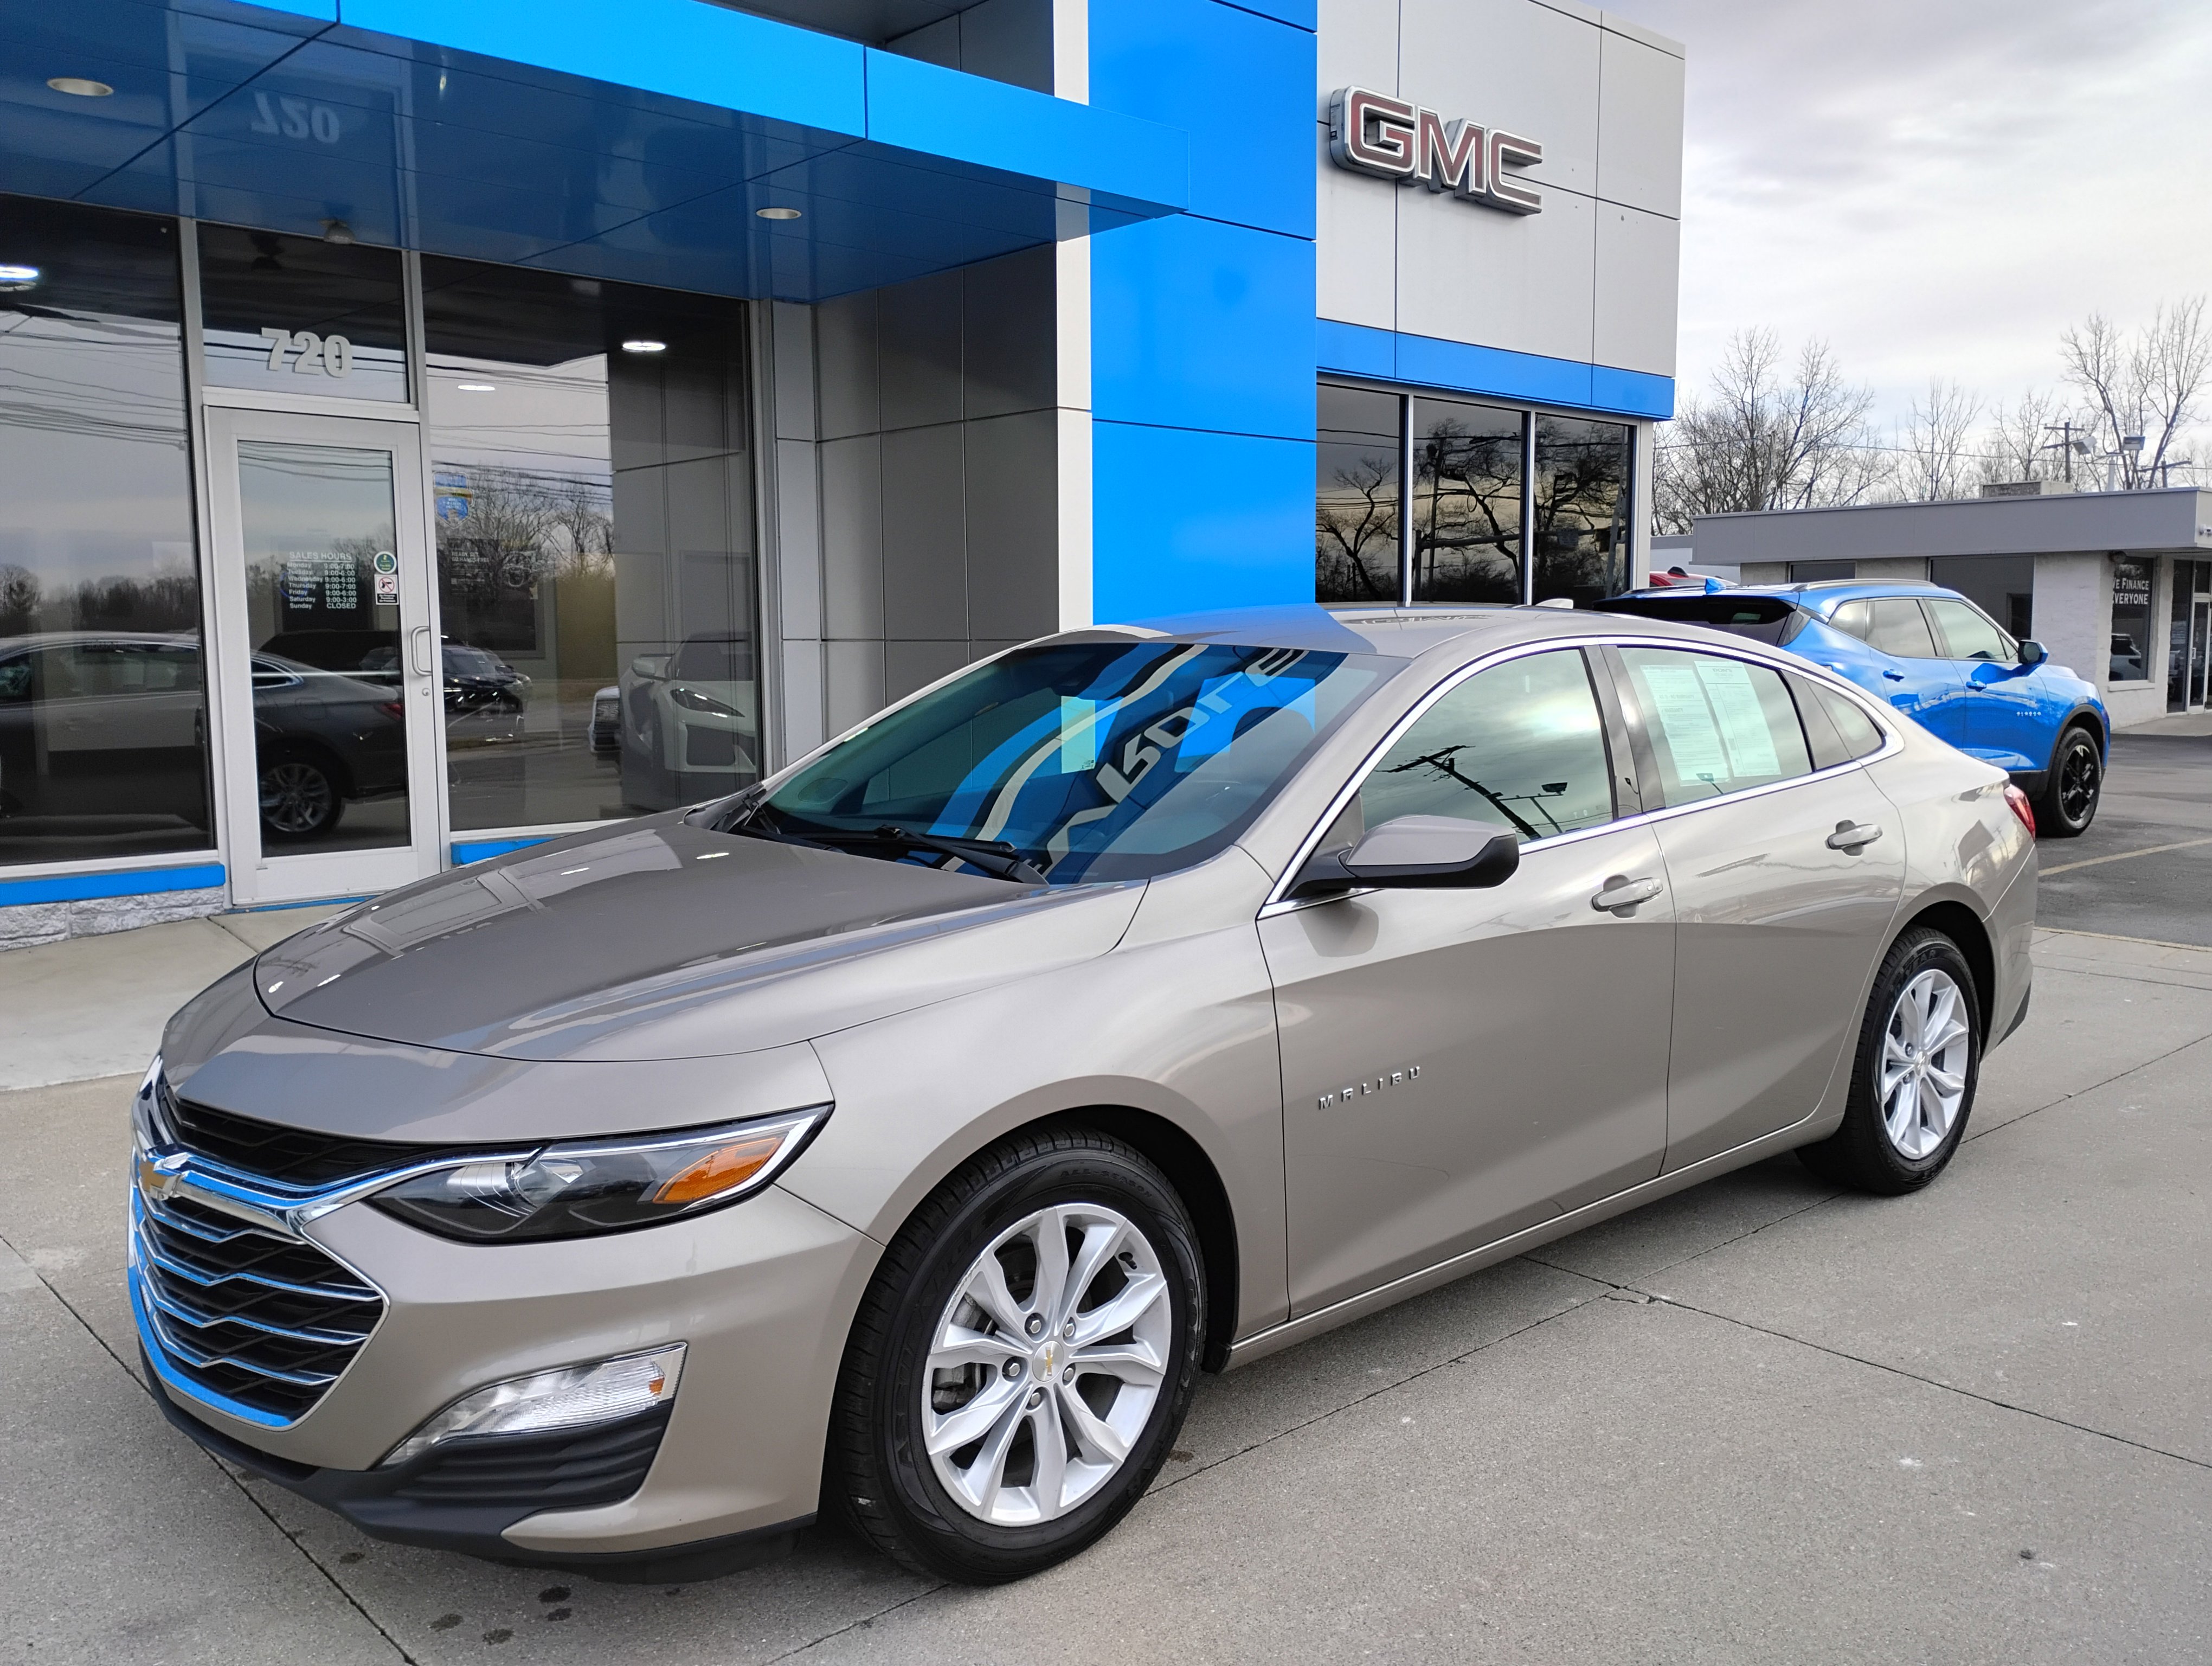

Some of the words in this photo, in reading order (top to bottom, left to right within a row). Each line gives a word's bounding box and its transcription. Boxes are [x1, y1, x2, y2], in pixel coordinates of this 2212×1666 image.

[1330, 86, 1543, 216] GMC
[261, 326, 353, 379] 720
[289, 551, 319, 560] SALES
[321, 552, 352, 560] HOURS
[2122, 578, 2149, 591] FINANCE
[1319, 1066, 1420, 1110] MALIBU
[1060, 1169, 1153, 1198] ALL-SEASON
